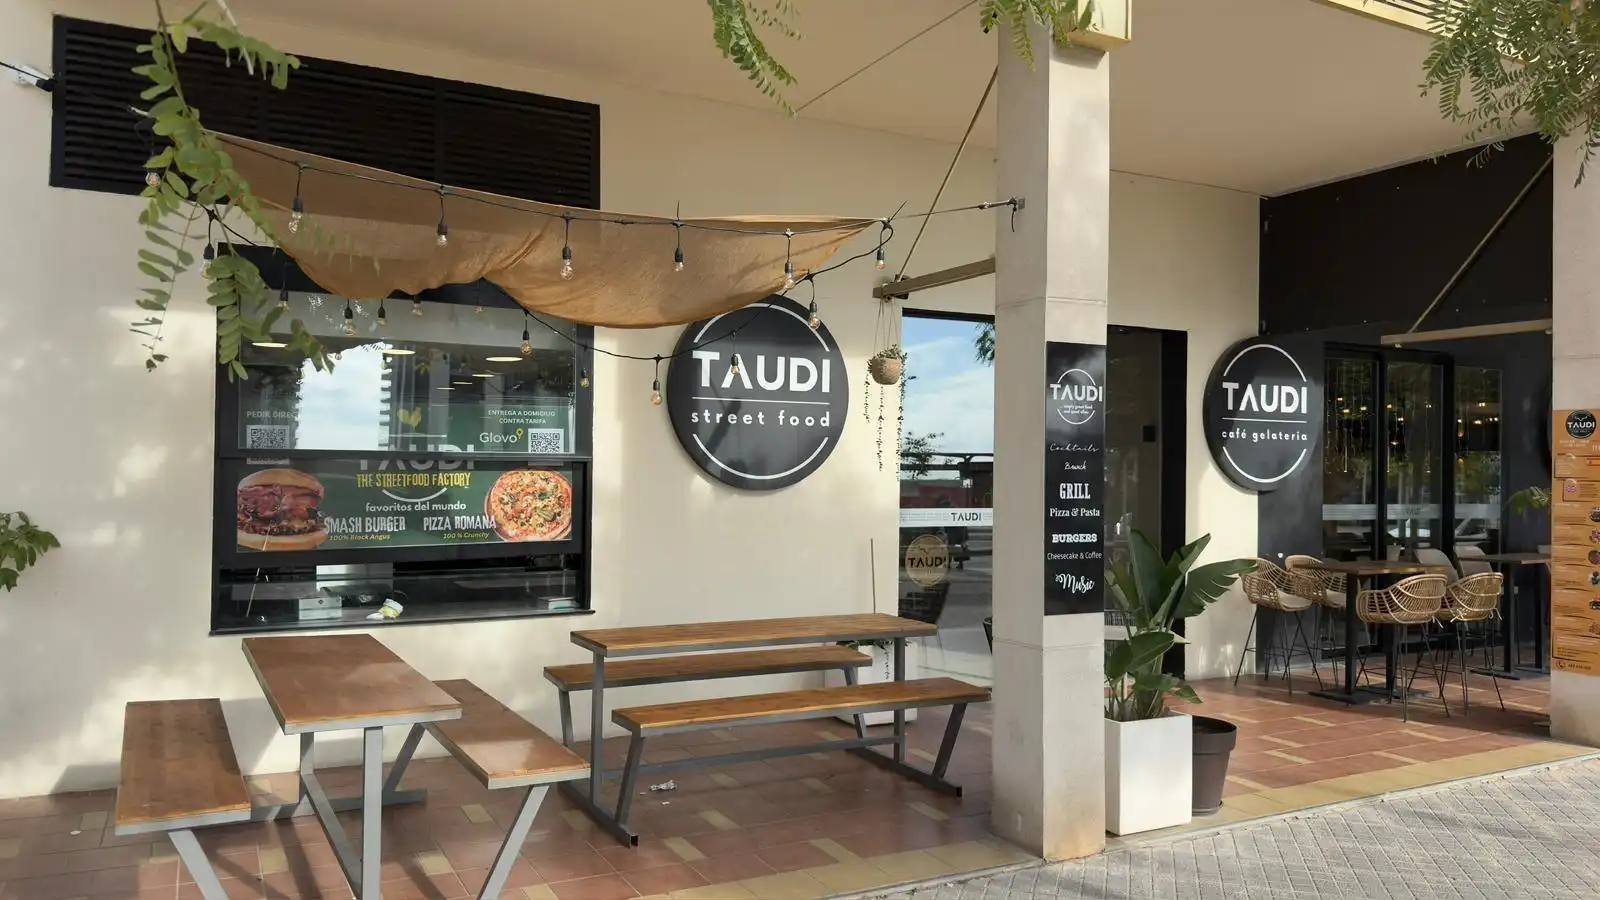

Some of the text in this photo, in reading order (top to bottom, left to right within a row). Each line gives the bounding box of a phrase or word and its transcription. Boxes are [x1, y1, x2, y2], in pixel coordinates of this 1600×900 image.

[692, 350, 830, 393] TAUDI
[1049, 383, 1103, 402] TAUDI
[1222, 381, 1307, 414] TAUDI
[246, 410, 271, 418] PEDIR
[691, 409, 830, 427] street food
[1567, 421, 1595, 429] TAUDI
[479, 432, 518, 444] Glovo
[1221, 427, 1308, 443] café gelateria
[1049, 443, 1099, 452] Cocktails
[356, 472, 471, 488] THE STREETFOOD FACTORY
[1059, 482, 1091, 500] GRILL
[365, 500, 467, 512] favoritos del mundo
[1049, 507, 1100, 517] Pizza & Pasta
[951, 512, 981, 521] TAUDI
[324, 516, 406, 533] SMASH BURGER
[423, 515, 497, 531] PIZZA ROMANA
[369, 534, 391, 542] Angus
[463, 531, 490, 540] Crunchy
[1052, 533, 1098, 543] BURGERS
[1047, 552, 1079, 560] Cheesecake
[1085, 551, 1103, 559] Coffee
